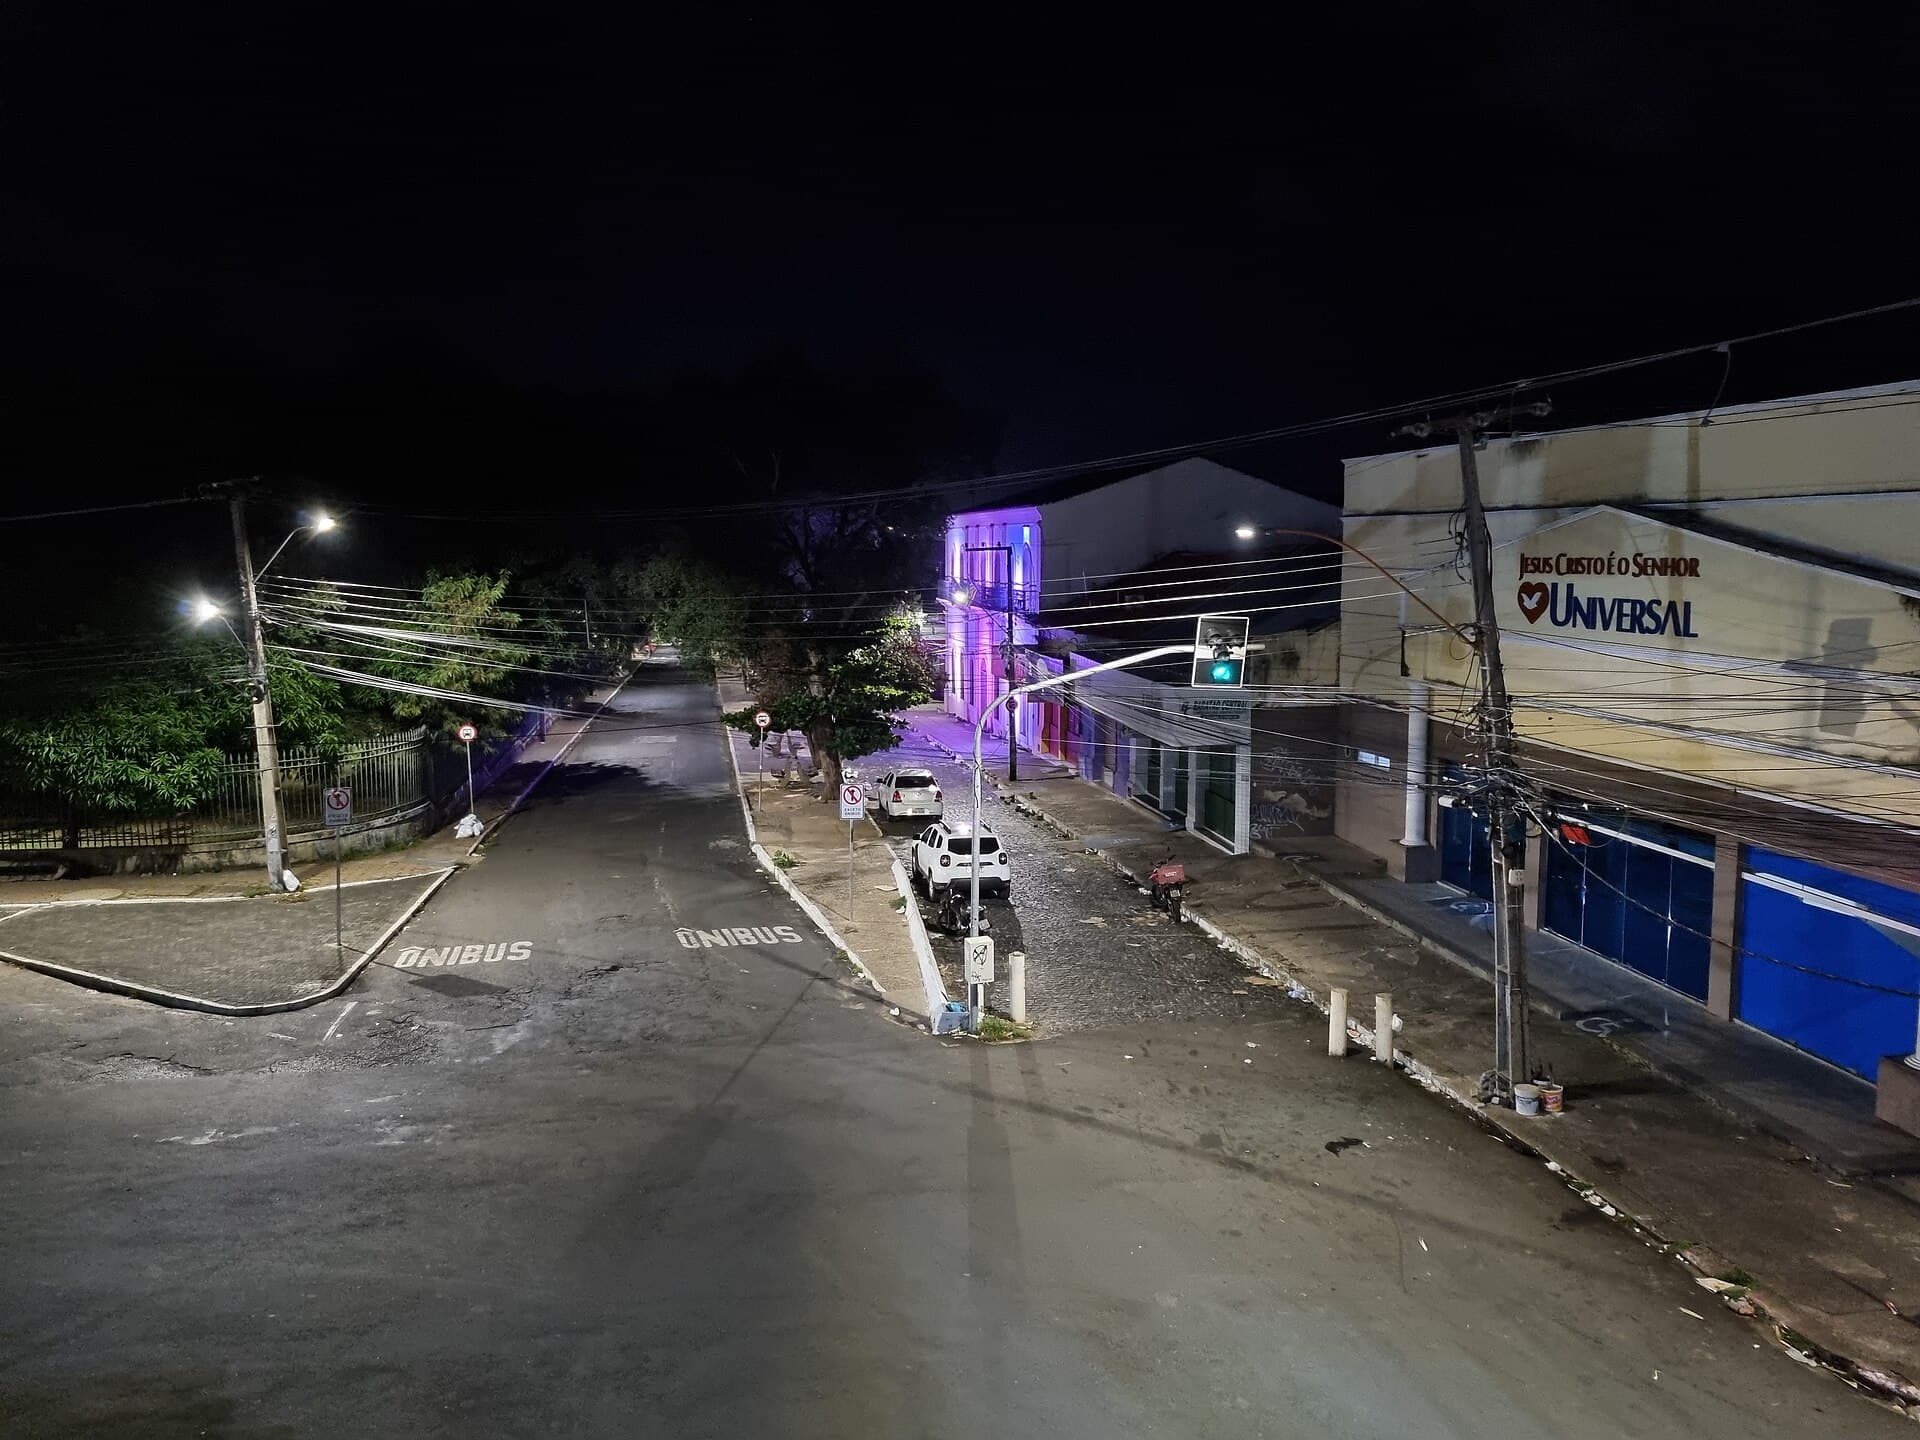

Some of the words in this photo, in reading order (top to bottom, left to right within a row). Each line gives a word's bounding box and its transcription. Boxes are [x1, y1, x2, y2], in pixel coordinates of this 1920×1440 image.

[1518, 552, 1553, 580] JESUS
[1555, 553, 1605, 576] CRISTO
[1607, 551, 1616, 575] É
[1617, 557, 1630, 576] O
[1632, 553, 1700, 578] SENHOR
[1549, 582, 1699, 638] UNIVERSAL
[674, 926, 804, 949] ÔNIBUS
[394, 940, 534, 969] ÔNIBUS
